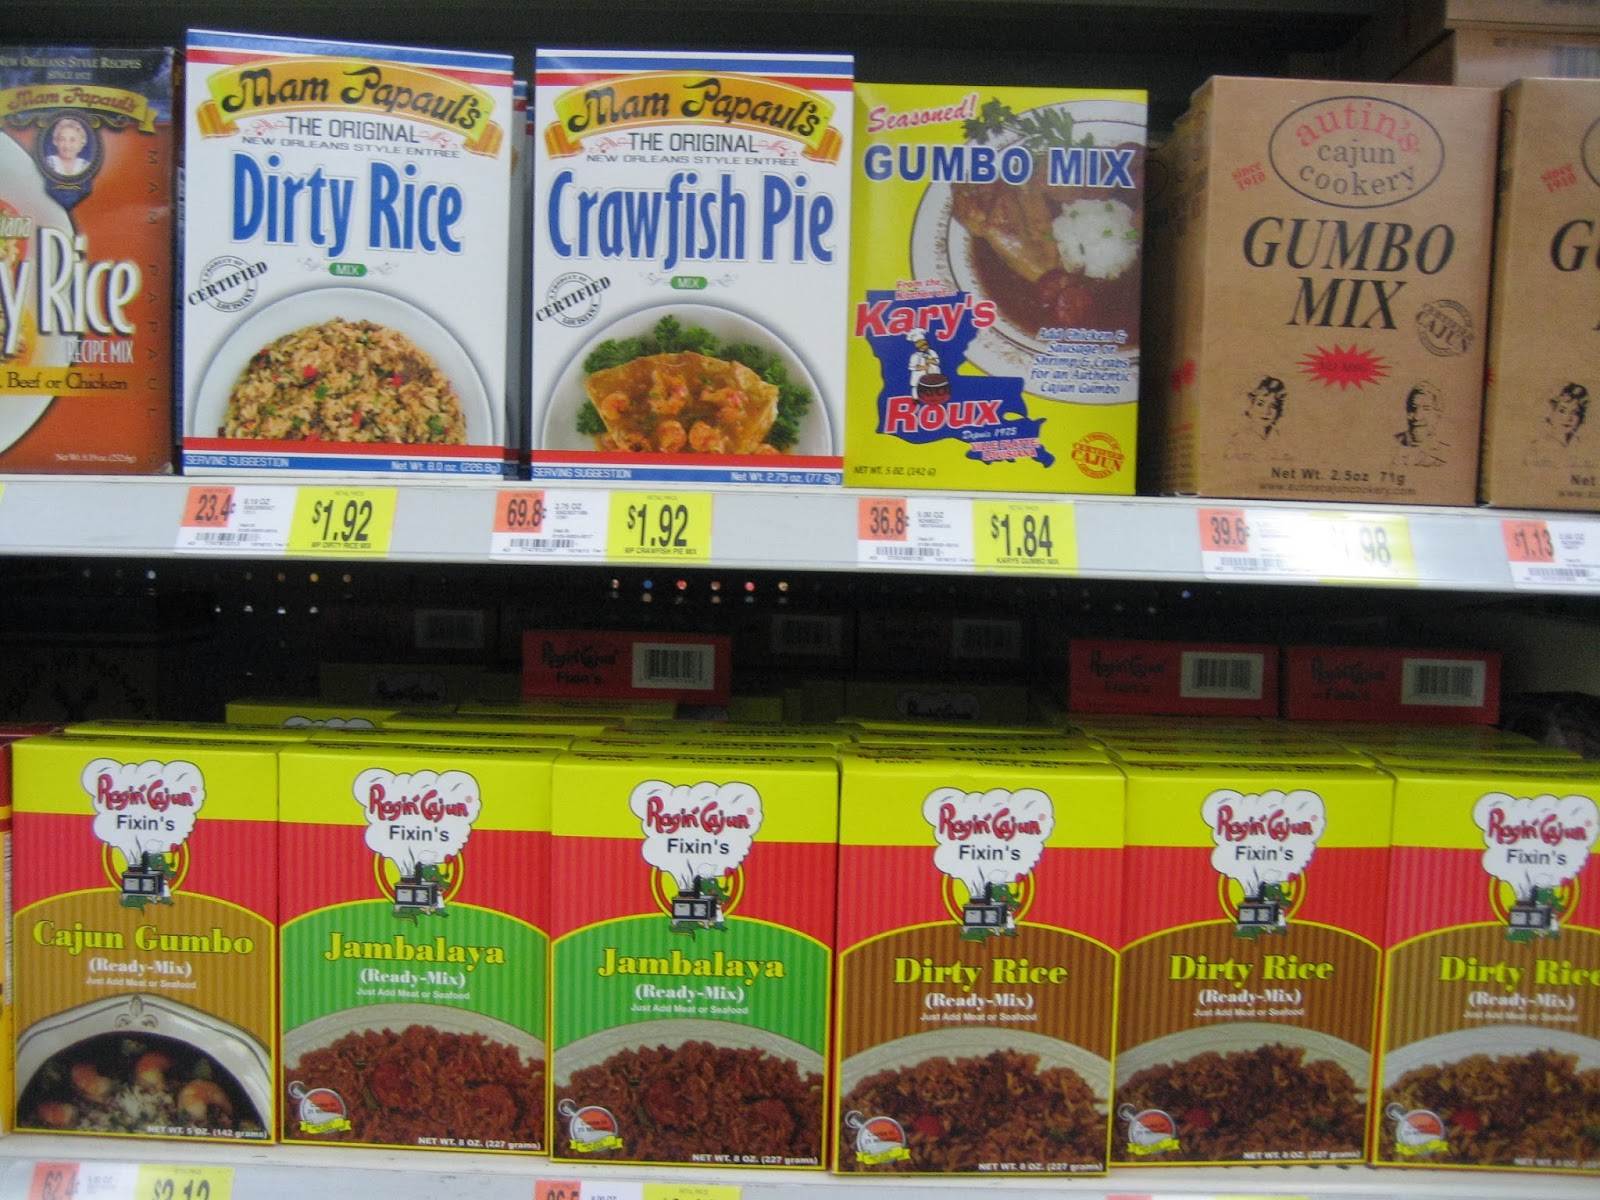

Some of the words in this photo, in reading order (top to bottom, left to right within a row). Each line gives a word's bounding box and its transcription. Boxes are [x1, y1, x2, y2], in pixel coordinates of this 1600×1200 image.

[67, 56, 98, 68] STYLE
[101, 57, 142, 69] RECIPES
[222, 68, 329, 112] Mam
[341, 67, 483, 129] Papaul's
[568, 87, 669, 133] Mam
[681, 77, 820, 137] Papaul's
[867, 93, 979, 133] Seasoned!
[286, 116, 323, 136] THE
[329, 120, 419, 143] ORIGINAL
[1297, 102, 1420, 152] autin's
[242, 136, 274, 145] NEW
[281, 138, 349, 150] ORLEANS
[354, 143, 401, 154] STYLE
[406, 147, 460, 158] ENTREE
[628, 133, 663, 151] THE
[670, 133, 758, 153] ORIGINAL
[587, 154, 618, 163] NEW
[623, 154, 690, 164] ORLEANS
[693, 155, 740, 165] STYLE
[745, 155, 799, 166] ENTREE
[1318, 140, 1395, 168] cajun
[864, 144, 1033, 185] GUMBO
[1048, 148, 1136, 188] MIX
[1301, 165, 1414, 196] cookery
[233, 154, 354, 257] Dirty
[369, 162, 462, 253] Rice
[549, 171, 746, 270] Crawfish
[762, 174, 834, 262] Pie
[1243, 217, 1454, 275] GUMBO
[335, 265, 360, 275] MIX
[40, 228, 136, 334] Rice
[188, 262, 268, 306] CERTIFIED
[677, 278, 701, 289] MIX
[536, 277, 611, 321] CERTIFIED
[1287, 277, 1407, 329] MIX
[854, 294, 997, 340] Kary's
[1040, 328, 1064, 339] Add
[1066, 328, 1113, 340] Chicken
[67, 339, 107, 363] RECIPE
[110, 340, 134, 363] MIX
[1049, 342, 1099, 354] Sausage
[1102, 345, 1117, 353] or
[1035, 355, 1077, 367] Shrimp
[7, 372, 41, 388] Beef
[46, 379, 61, 389] or
[66, 373, 127, 389] Chicken
[1073, 370, 1129, 380] Authentic
[1041, 382, 1075, 393] Cajun
[1079, 383, 1120, 393] Gumbo
[885, 396, 1002, 433] Roux
[186, 455, 227, 465] SERVING
[229, 456, 289, 467] SUGGESTION
[982, 448, 1038, 460] LOUISIANA
[1072, 450, 1121, 471] CAJUN
[391, 460, 407, 470] Net
[409, 461, 424, 470] Wt.
[533, 467, 572, 477] SERVING
[574, 468, 632, 479] SUGGESTION
[731, 472, 747, 481] Net
[749, 472, 765, 481] Wt.
[766, 473, 788, 482] 2.75
[1272, 467, 1296, 479] Net
[1302, 468, 1324, 480] Wt.
[1331, 469, 1369, 481] 2.5oz
[1380, 471, 1406, 485] 71g
[312, 499, 373, 542] $1.92
[627, 504, 688, 547] $1.92
[991, 514, 1053, 557] $1.84
[98, 774, 146, 811] Ragin'
[147, 779, 193, 812] Cajun
[370, 784, 420, 821] Ragin'
[421, 789, 468, 822] Cajun
[117, 815, 175, 831] Fixin's
[648, 796, 699, 834] Ragin'
[700, 801, 750, 835] Cajun
[939, 803, 991, 840] Ragin'
[992, 808, 1042, 841] Cajun
[389, 825, 449, 842] Fixin's
[667, 838, 729, 854] Fixin's
[959, 845, 1021, 861] Fixin's
[1235, 845, 1294, 860] Fixin's
[1506, 849, 1568, 865] Fixin's
[33, 920, 124, 955] Cajun
[135, 925, 253, 954] Gumbo
[325, 932, 504, 972] Jambalaya
[89, 957, 192, 976] (Ready-Mix)
[598, 948, 785, 986] Jambalaya
[894, 958, 982, 992] Dirty
[992, 958, 1068, 985] Rice
[1170, 955, 1254, 989] Dirty
[1263, 955, 1335, 980] Rice
[1440, 956, 1525, 992] Dirty
[360, 968, 466, 988] (Ready-Mix)
[357, 988, 375, 996] Just
[377, 989, 396, 997] Add
[398, 990, 419, 998] Meat
[433, 990, 470, 1000] Seafood
[635, 984, 744, 1002] (Ready-Mix)
[925, 993, 1034, 1011] (Ready-Mix)
[1199, 989, 1302, 1006] (Ready-Mix)
[1469, 991, 1575, 1010] (Ready-Mix)
[147, 1126, 168, 1134] NET
[169, 1127, 184, 1135] WT.
[195, 1128, 211, 1136] OZ.
[213, 1129, 233, 1138] (142
[235, 1130, 268, 1139] grams)
[418, 1137, 437, 1145] NET
[440, 1138, 457, 1146] WT.
[467, 1139, 483, 1147] OZ.
[485, 1139, 506, 1148] (227
[508, 1141, 541, 1150] grams)
[692, 1153, 712, 1162] NET
[714, 1154, 732, 1162] WT.
[742, 1155, 759, 1163] OZ.
[761, 1155, 782, 1165] (227
[784, 1156, 818, 1165] grams)
